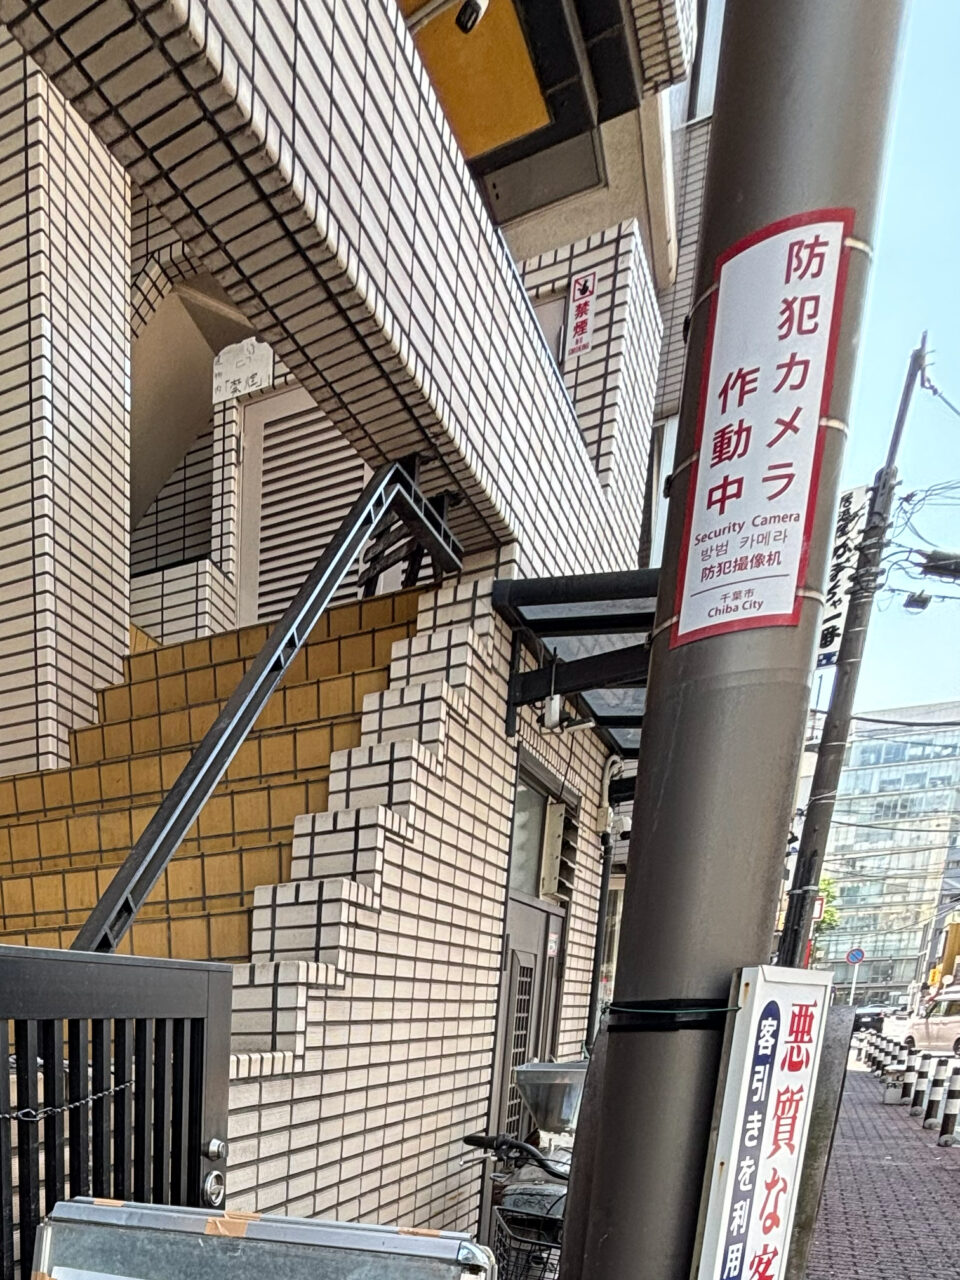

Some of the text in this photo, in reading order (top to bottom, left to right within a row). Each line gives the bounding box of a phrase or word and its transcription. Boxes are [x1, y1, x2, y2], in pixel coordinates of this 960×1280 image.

[573, 300, 590, 338] 禁煙
[761, 234, 830, 502] 防犯カメラ
[705, 366, 760, 516] 作動中
[694, 513, 801, 546] Security Camera
[701, 528, 789, 562] 방범 카메라
[707, 600, 764, 618] Chiba City
[720, 588, 756, 603] 千葉市
